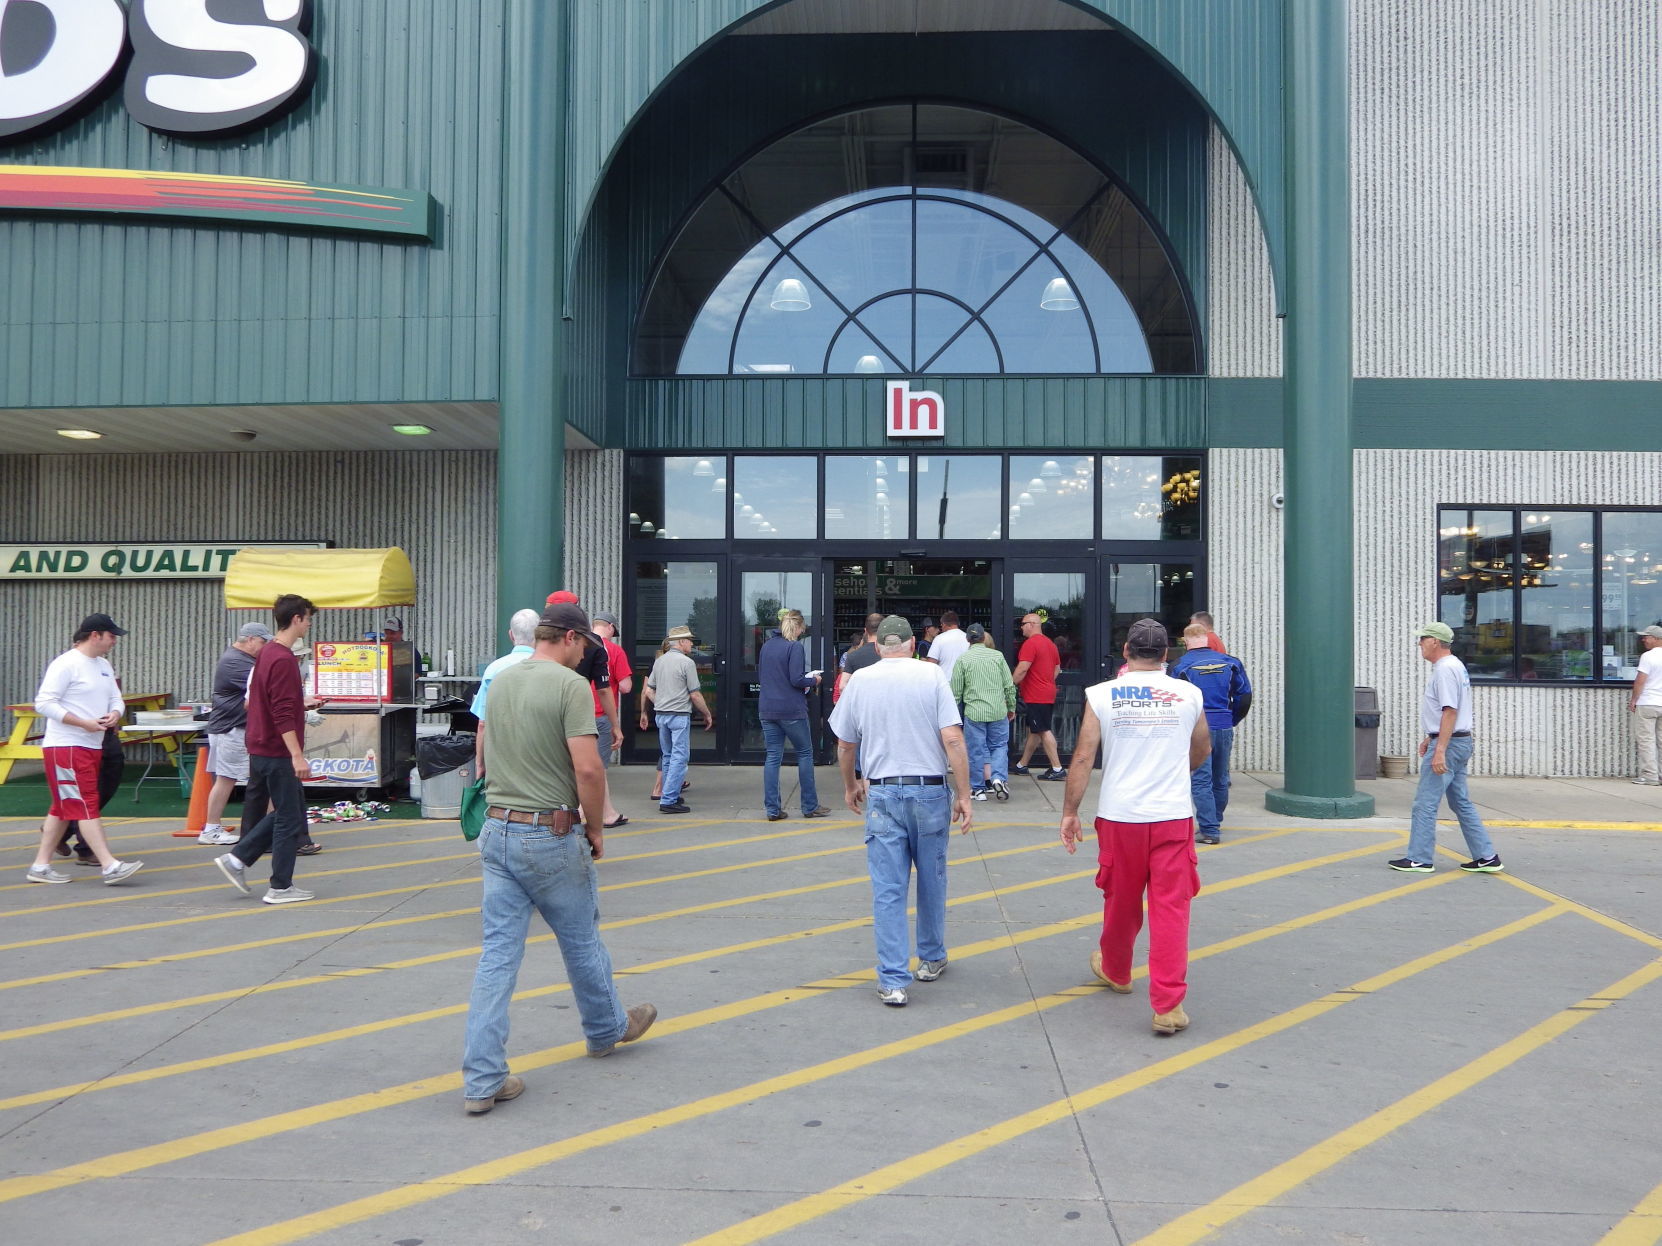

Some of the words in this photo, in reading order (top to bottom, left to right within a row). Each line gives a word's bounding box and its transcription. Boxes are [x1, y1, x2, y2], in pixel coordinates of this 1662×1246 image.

[893, 387, 938, 430] In
[8, 550, 90, 573] AND
[100, 549, 240, 575] QUALIT
[1112, 686, 1152, 700] NRA
[1112, 700, 1172, 708] SPORTS
[308, 759, 376, 773] GKOTA
